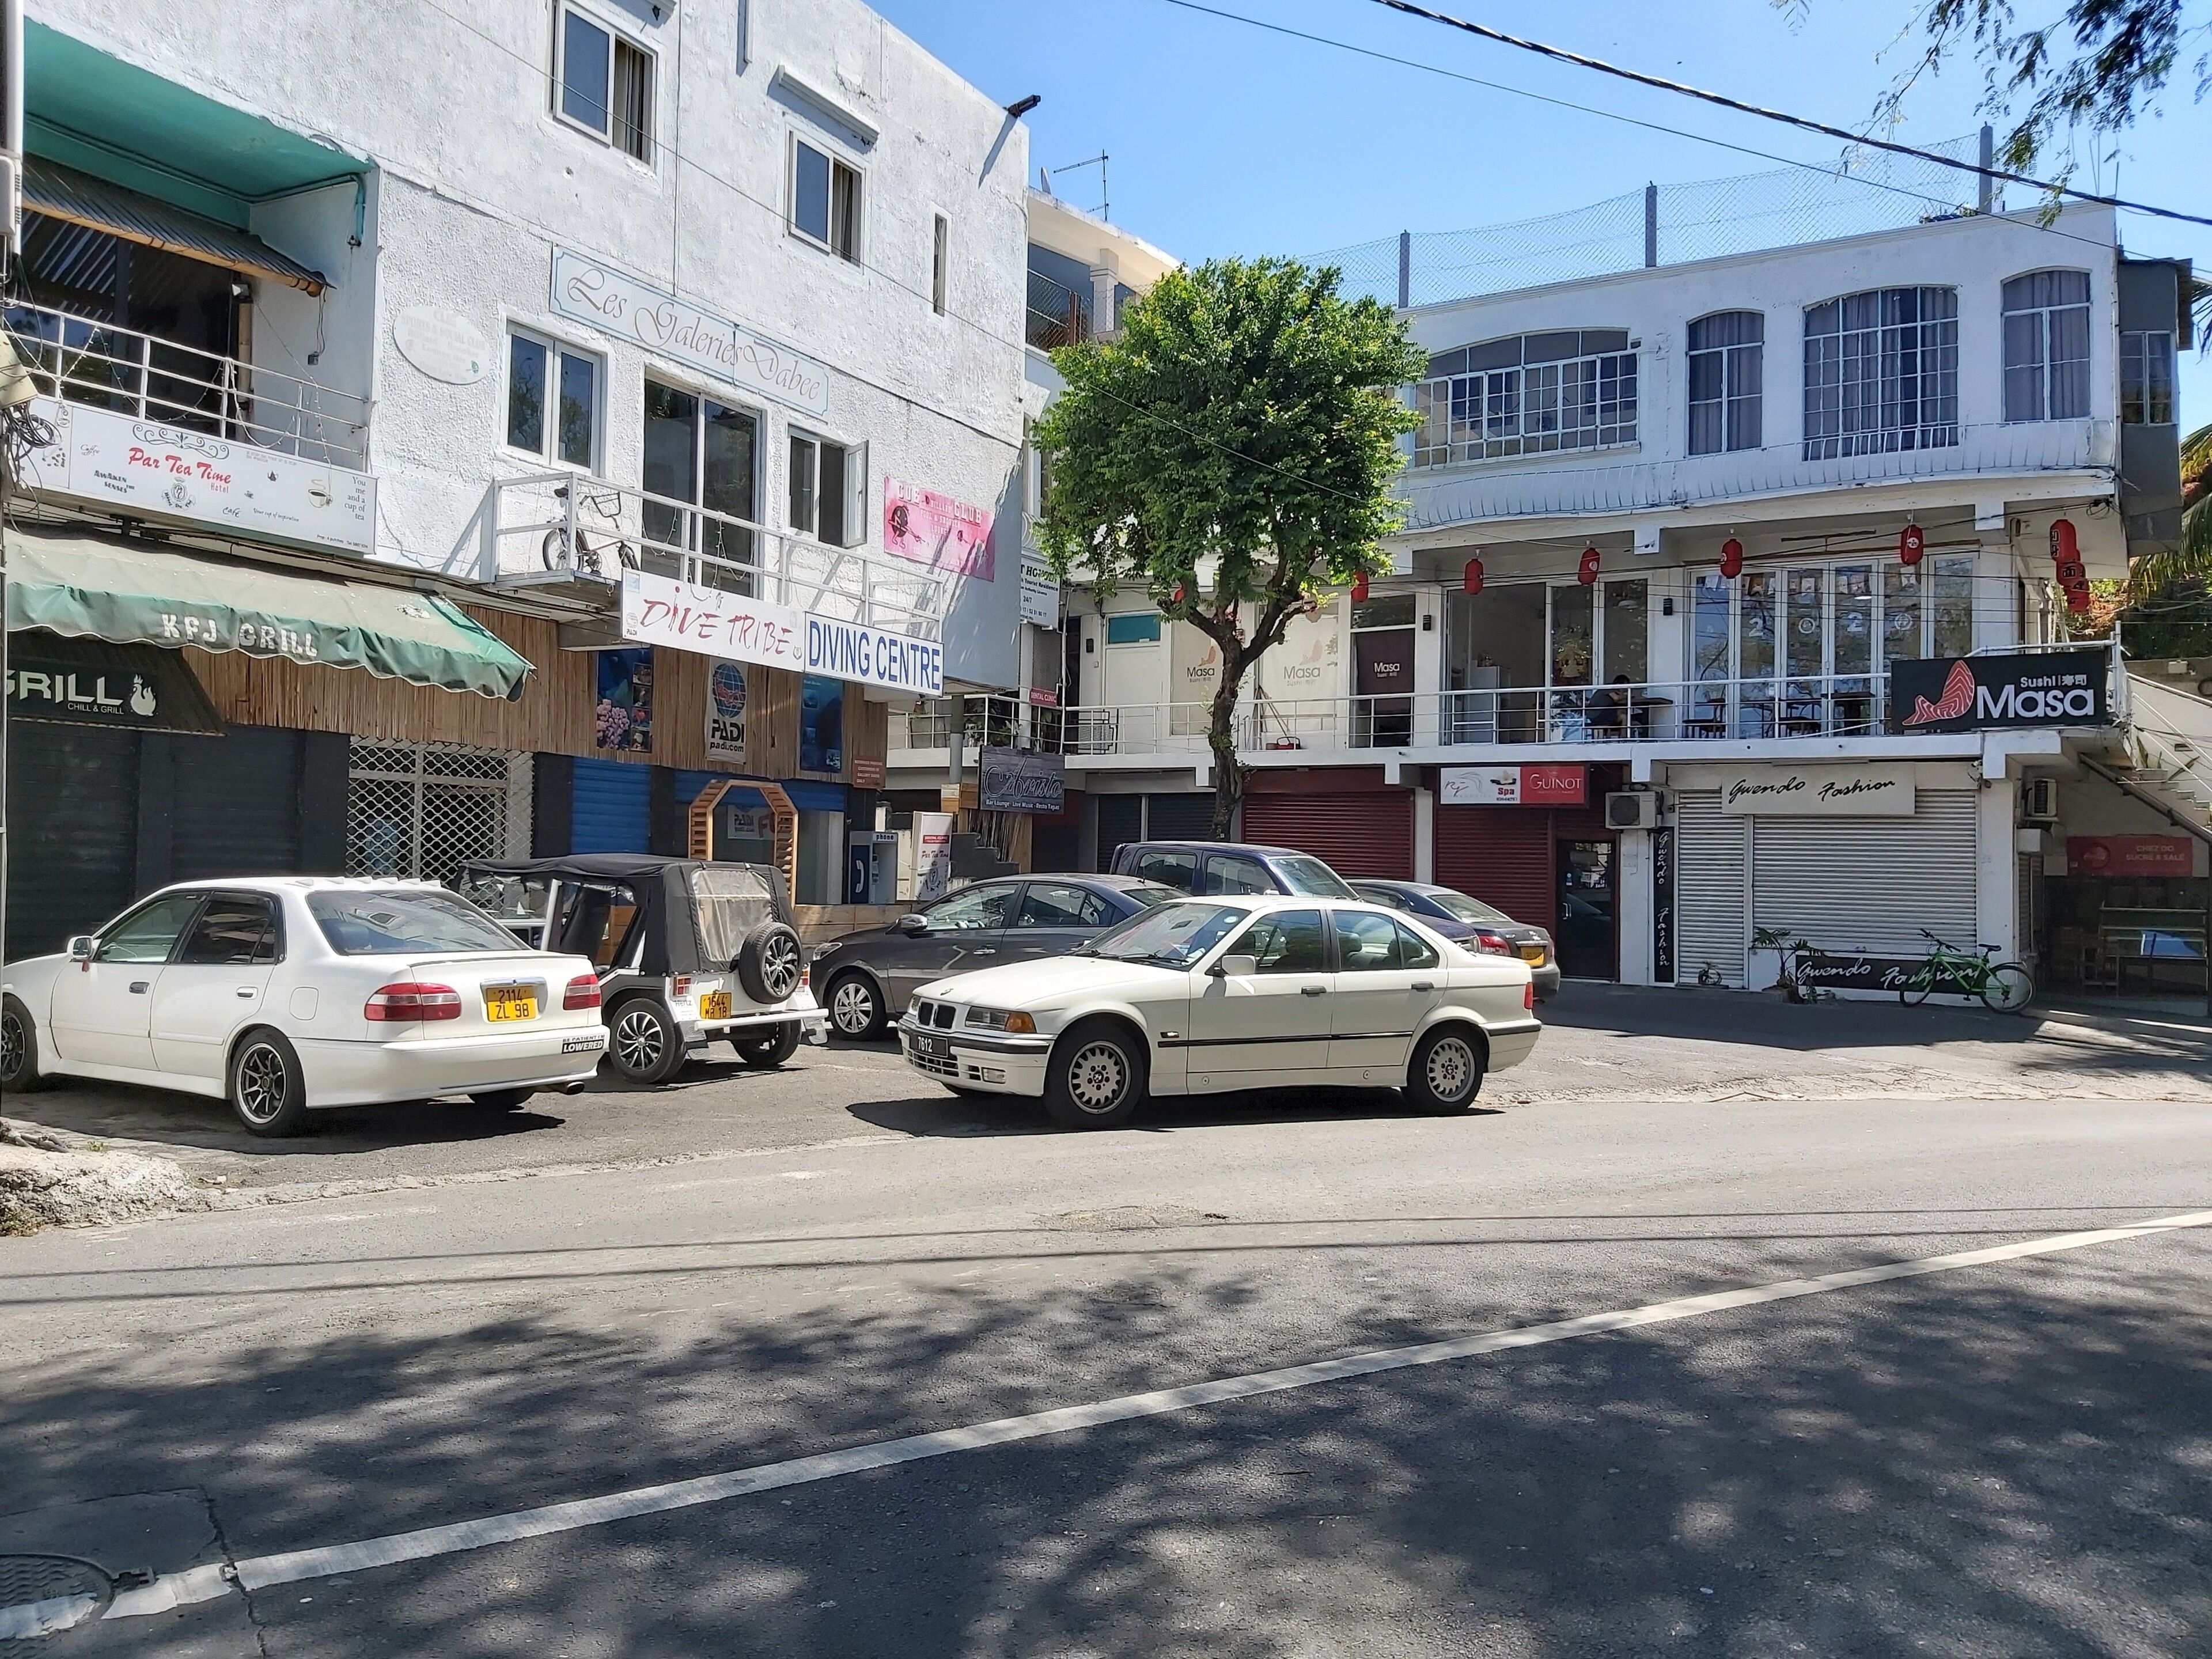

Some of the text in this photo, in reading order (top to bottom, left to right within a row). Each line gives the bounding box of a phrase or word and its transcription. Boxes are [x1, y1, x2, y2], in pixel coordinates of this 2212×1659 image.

[567, 268, 820, 399] Les Galeries Dabee
[128, 447, 232, 484] Par Tea Time
[352, 476, 366, 487] You
[347, 494, 361, 503] and
[344, 502, 366, 513] cup of
[953, 502, 982, 525] CLUB
[1023, 596, 1032, 604] 24/7
[161, 613, 317, 657] KFJ GRILL
[626, 628, 638, 637] PADI
[728, 614, 794, 656] TRIBE
[809, 620, 940, 691] DIVING CENTRE
[1187, 666, 1215, 677] Masa
[1284, 666, 1321, 680] Masa
[1374, 662, 1400, 673] Masa
[2020, 676, 2056, 688] Sushi
[67, 702, 125, 715] CHILL & GRILL
[1976, 684, 2094, 719] Masa
[711, 718, 745, 743] PADI
[710, 741, 744, 752] padi.com
[983, 756, 1063, 799] Aristo
[1530, 774, 1582, 789] GUINOT
[1498, 787, 1515, 796] Spa
[1728, 777, 1896, 805] Gwendo Fashion
[994, 800, 1010, 808] Lounge
[734, 813, 755, 827] PADI
[1657, 831, 1671, 966] Gwendo Fashion
[1796, 957, 1872, 985] Gwendo
[497, 988, 523, 1004] 2114
[707, 995, 725, 1008] 1644
[495, 1003, 529, 1020] ZL 98
[718, 1006, 727, 1018] 18
[563, 1040, 603, 1053] LOWERED
[918, 1036, 933, 1052] 7612
